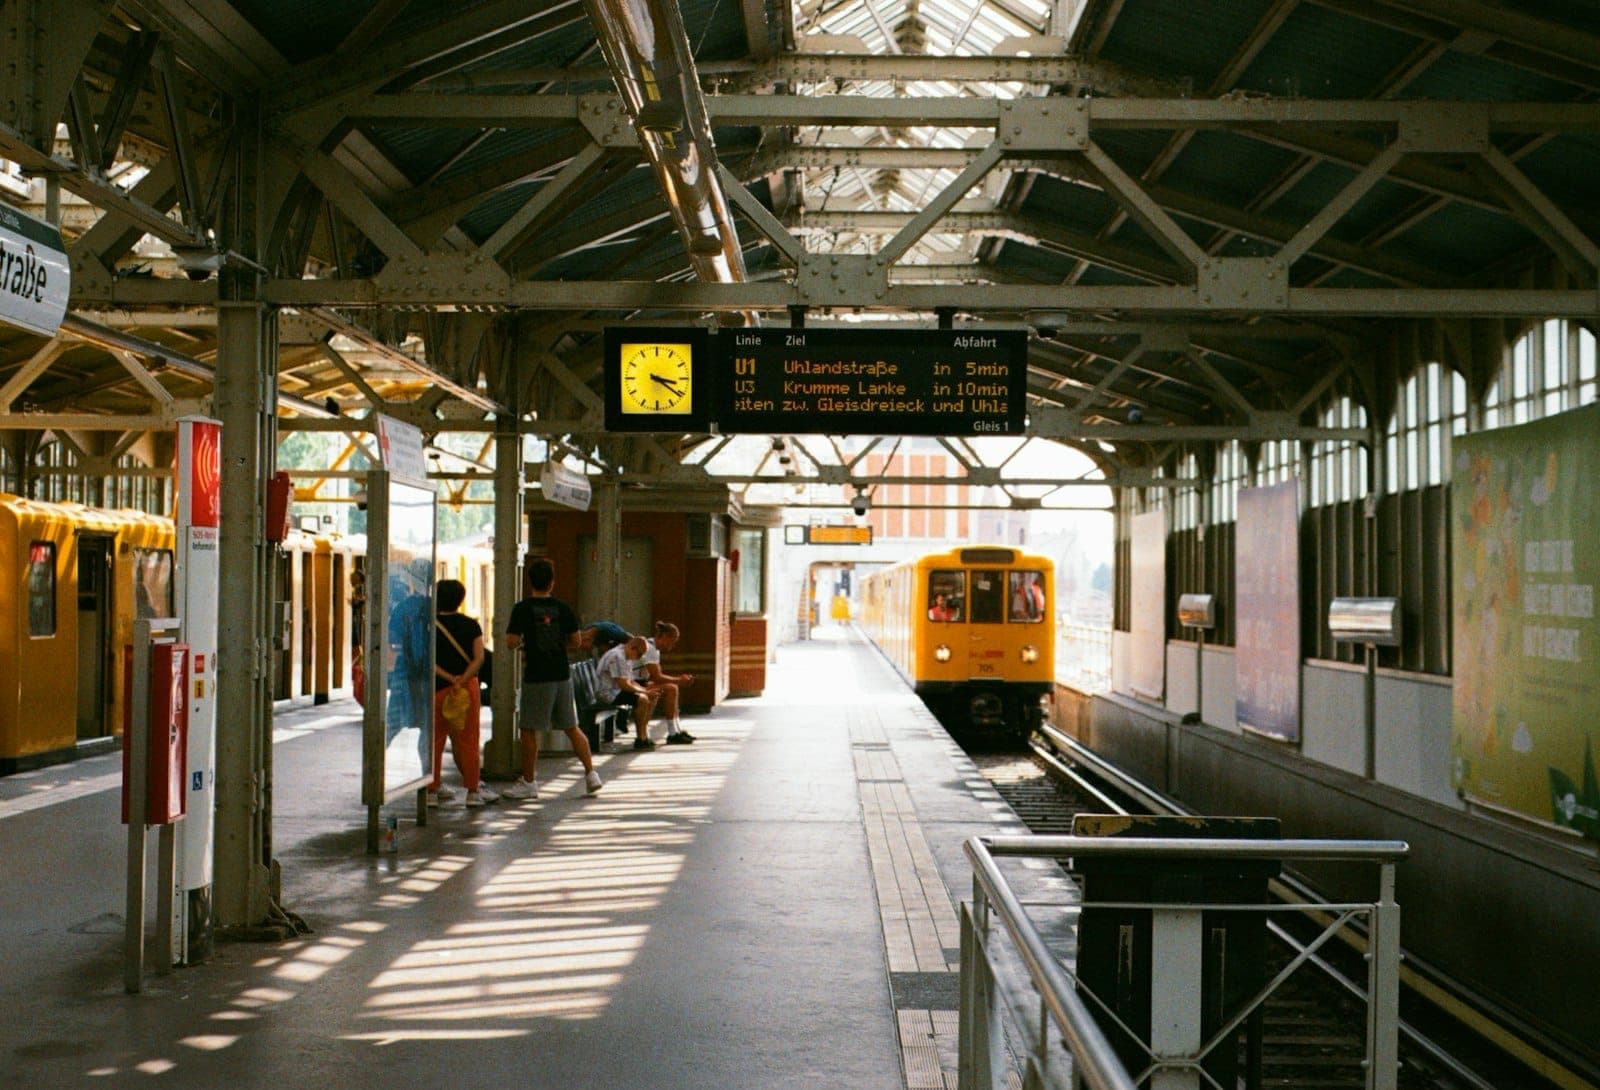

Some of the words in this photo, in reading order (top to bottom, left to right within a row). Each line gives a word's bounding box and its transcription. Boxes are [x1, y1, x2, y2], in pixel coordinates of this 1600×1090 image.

[735, 335, 762, 346] Linie
[785, 335, 806, 346] Ziel
[953, 336, 997, 348] Abfahrt
[735, 357, 756, 375] U1
[784, 360, 898, 377] Uhlandstraße
[933, 361, 951, 376] in
[735, 380, 756, 394] U3
[784, 380, 850, 395] Krumme
[858, 381, 906, 395] Lanke
[933, 382, 951, 396] in
[782, 400, 809, 411] zw.
[817, 399, 924, 412] Gleisdreieck
[932, 400, 964, 413] und
[973, 420, 1001, 431] Gleis
[1003, 421, 1009, 431] 1
